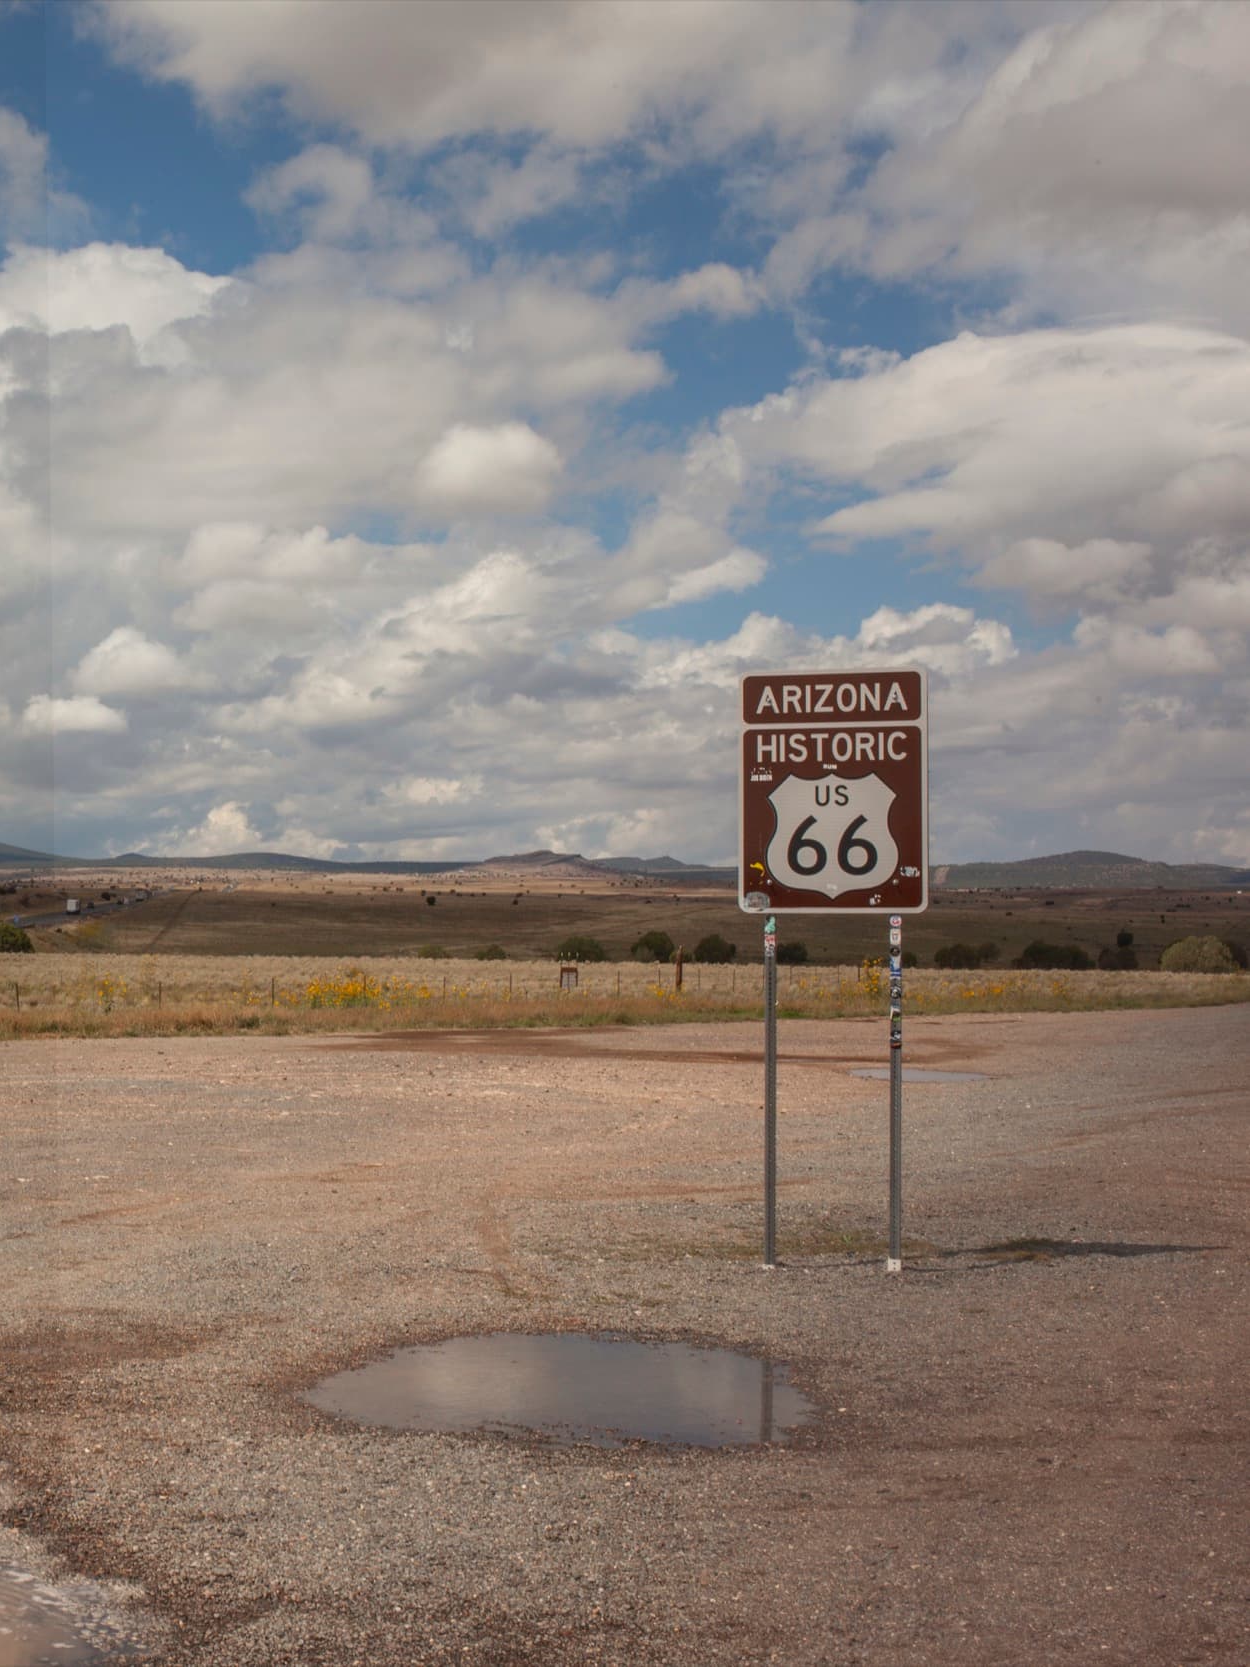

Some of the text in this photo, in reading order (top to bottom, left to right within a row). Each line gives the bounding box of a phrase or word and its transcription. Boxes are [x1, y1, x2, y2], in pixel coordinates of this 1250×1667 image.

[756, 682, 908, 714] ARIZONA
[757, 731, 907, 763] HISTORIC
[815, 784, 849, 807] US
[787, 814, 878, 876] 66
